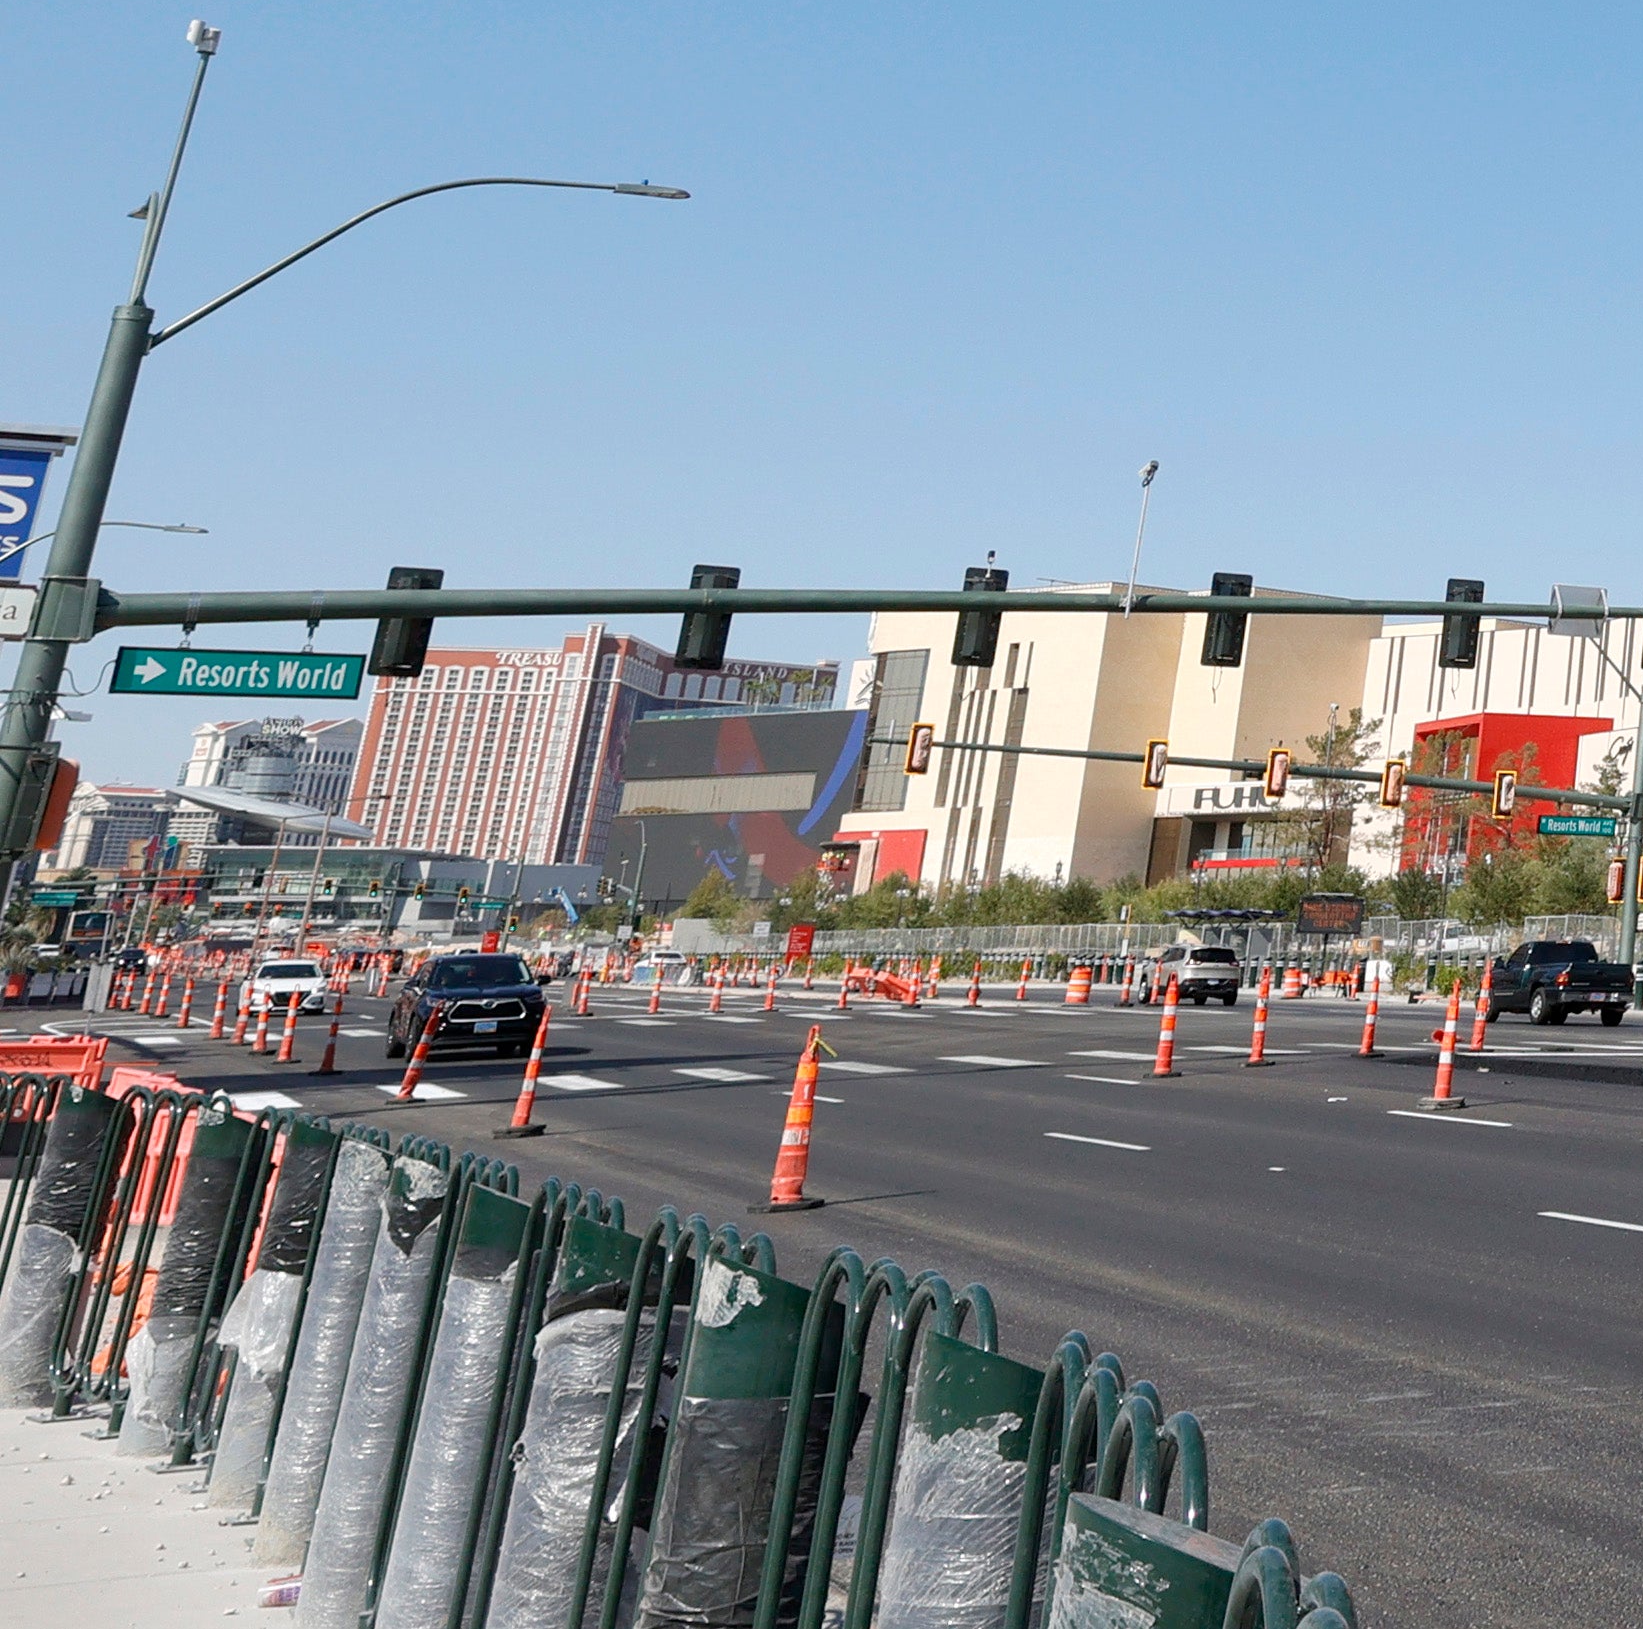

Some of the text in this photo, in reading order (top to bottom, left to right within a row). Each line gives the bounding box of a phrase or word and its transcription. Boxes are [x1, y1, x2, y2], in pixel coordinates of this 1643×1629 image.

[496, 652, 562, 668] TREASU
[178, 657, 348, 691] Resorts World
[1547, 818, 1577, 832] Resorts
[1578, 820, 1601, 833] World
